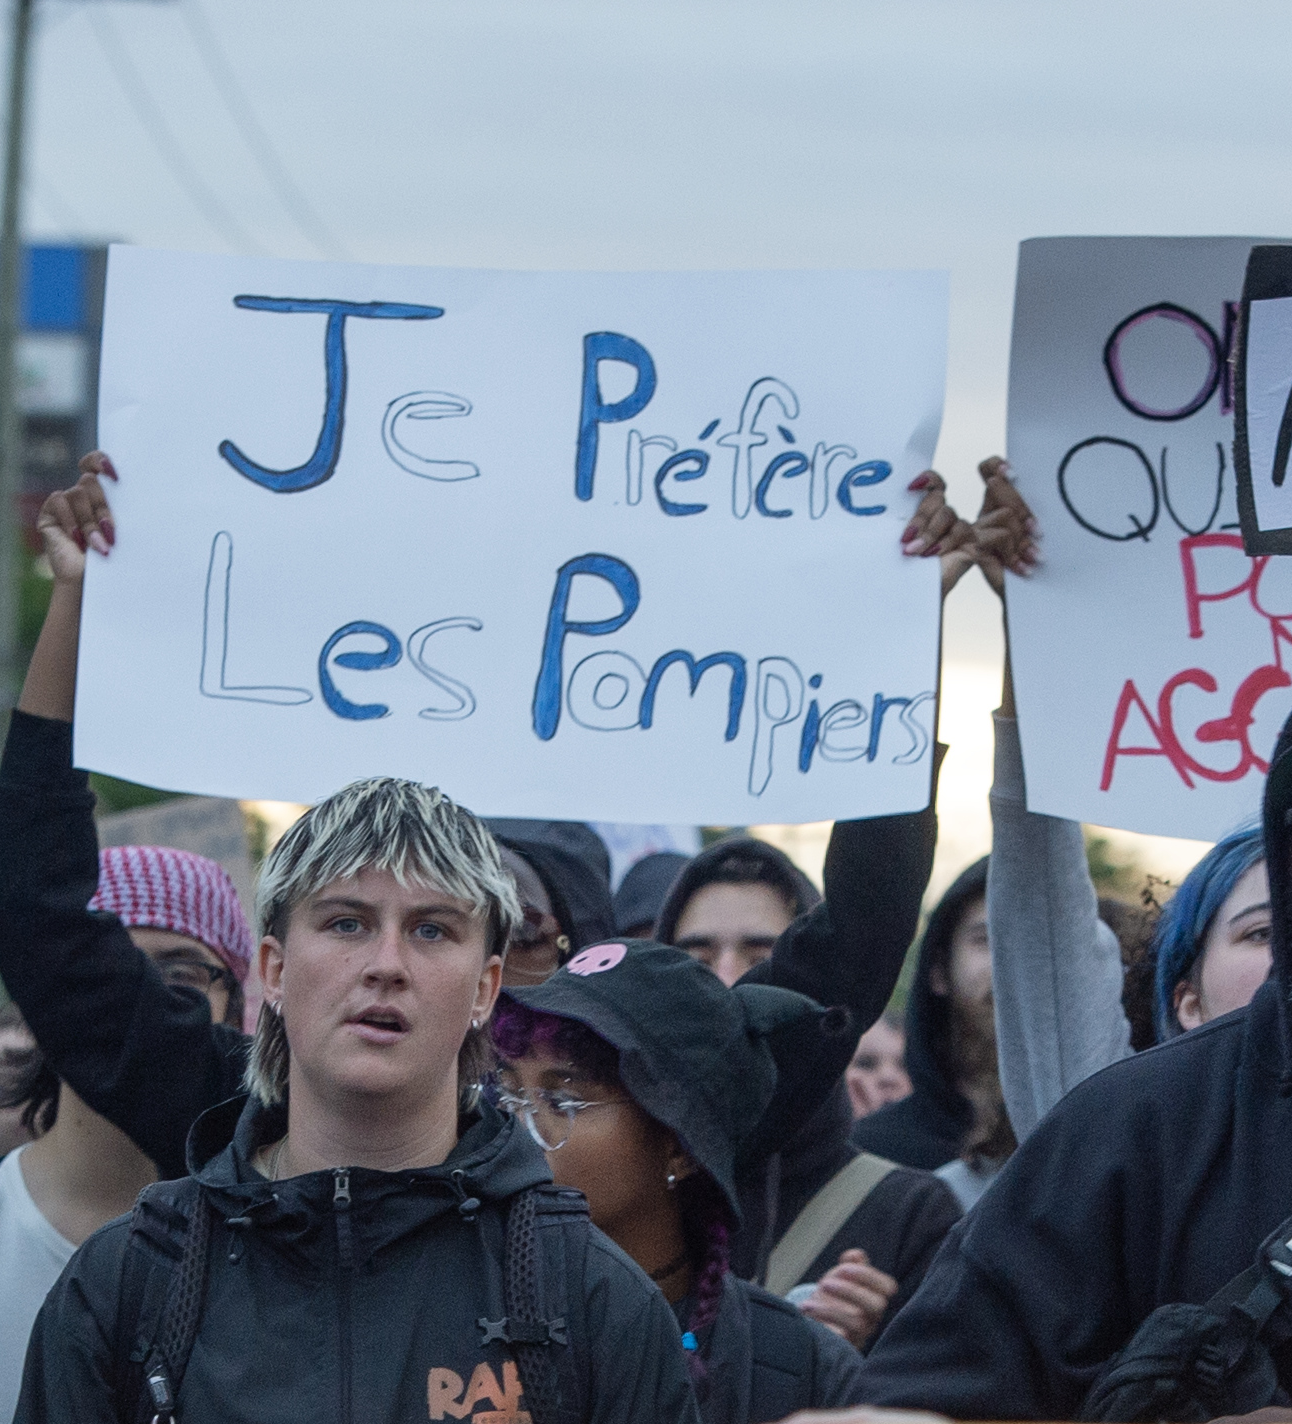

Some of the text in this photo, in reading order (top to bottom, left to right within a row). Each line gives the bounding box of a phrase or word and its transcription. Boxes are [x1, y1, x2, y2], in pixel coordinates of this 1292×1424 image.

[218, 294, 893, 520] Je Préfère
[1103, 302, 1240, 422] O
[200, 531, 939, 797] Les Pompiers
